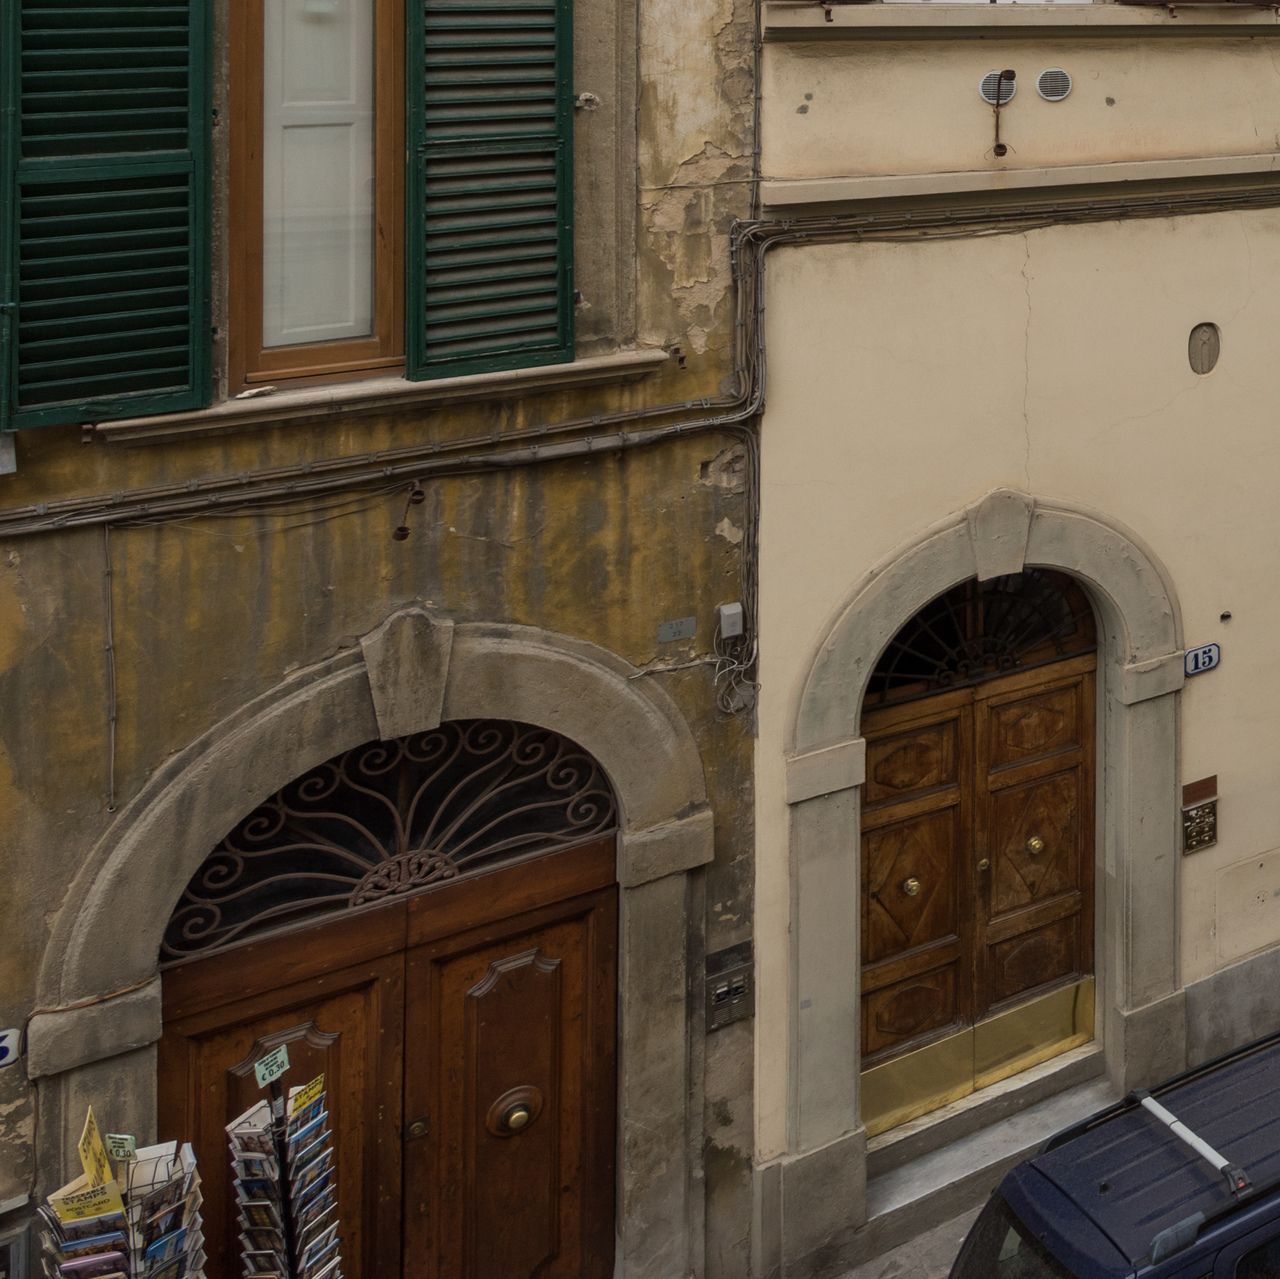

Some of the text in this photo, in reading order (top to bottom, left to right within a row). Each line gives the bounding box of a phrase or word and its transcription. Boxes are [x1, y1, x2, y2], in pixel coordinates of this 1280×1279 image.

[1191, 648, 1213, 672] 15
[268, 1061, 284, 1077] 0.30
[115, 1149, 131, 1158] 0.30
[63, 1191, 107, 1205] STAMPS
[66, 1199, 110, 1212] POSTCARD
